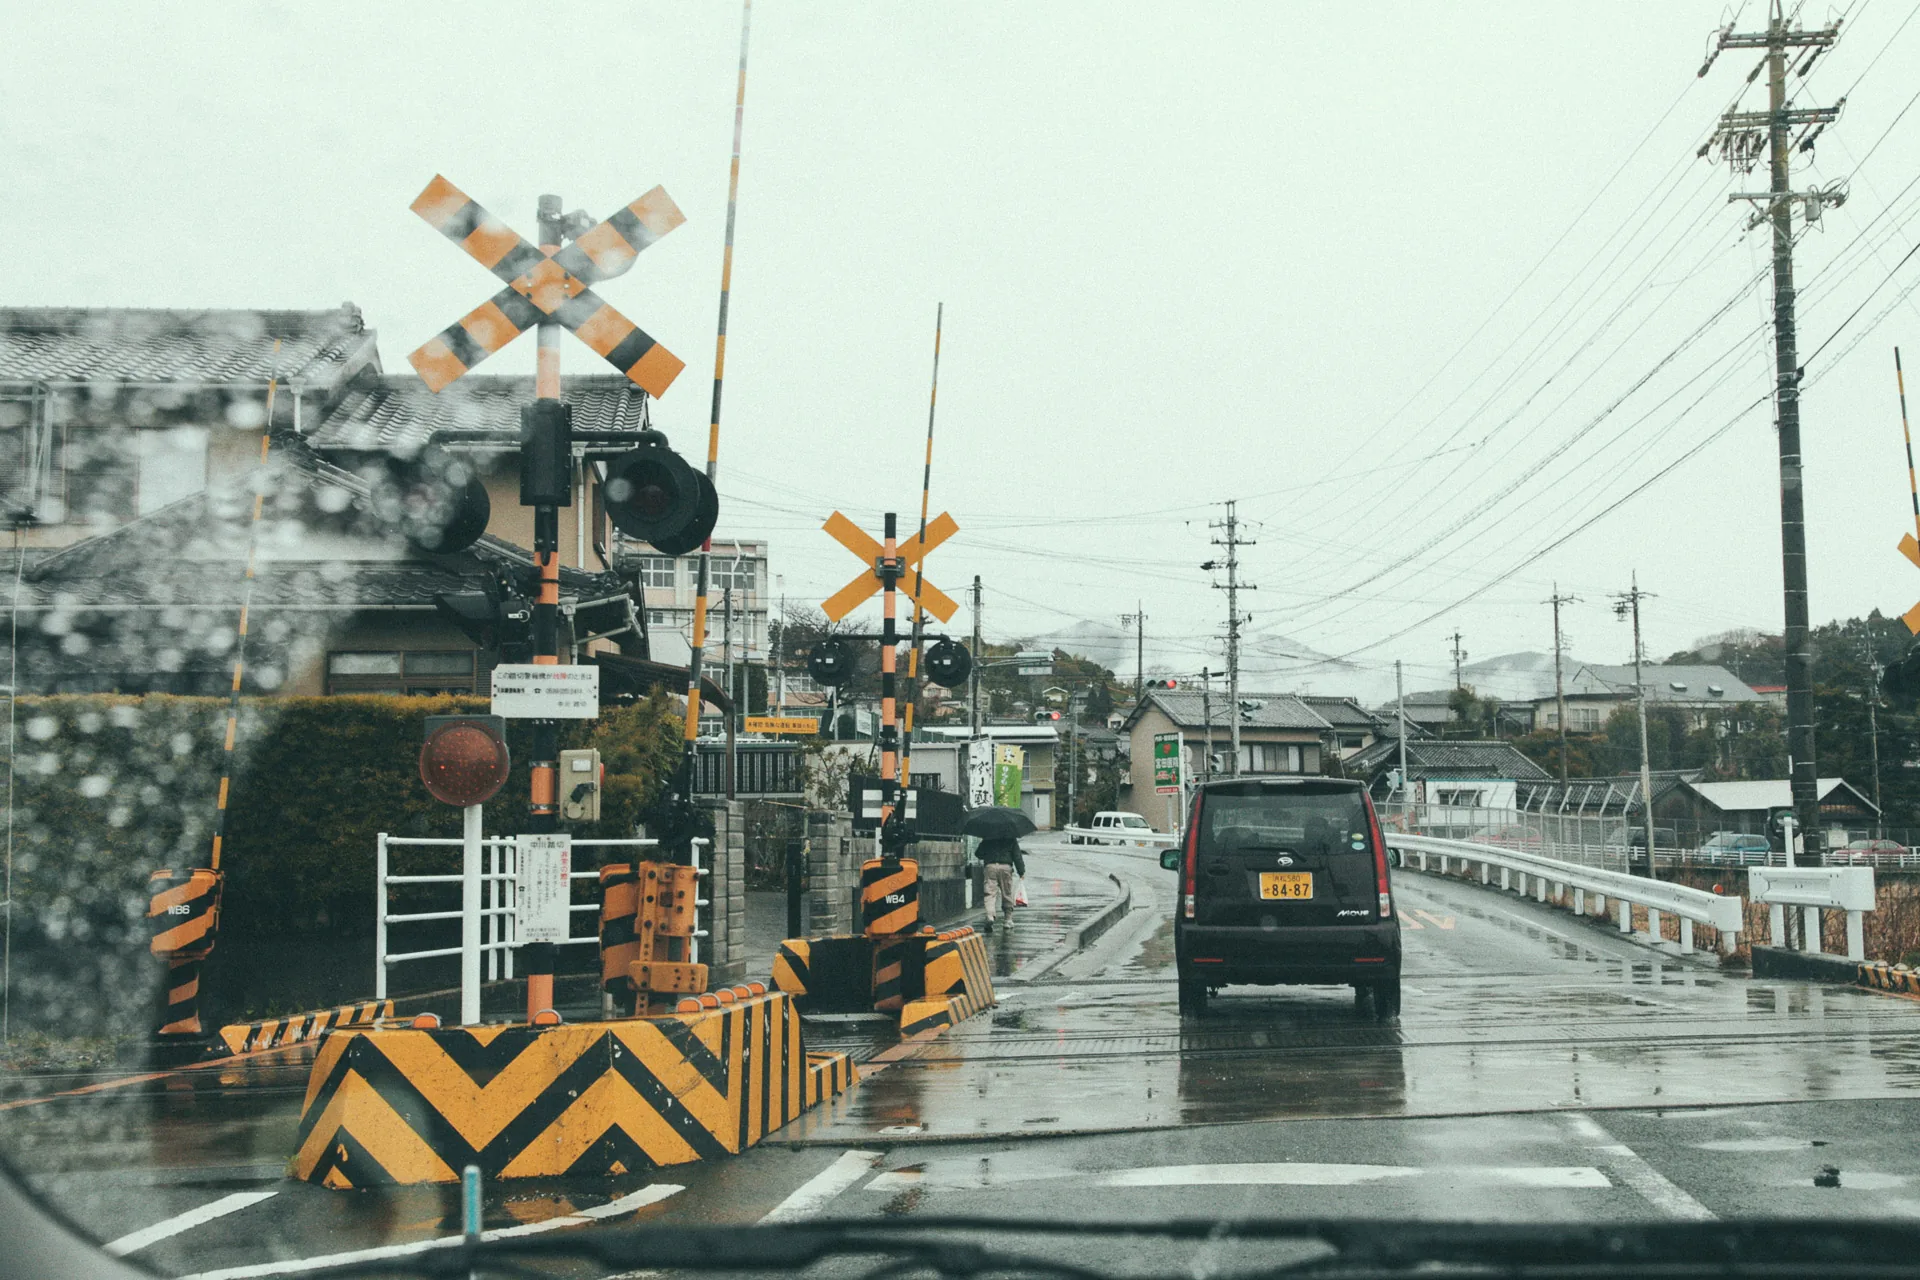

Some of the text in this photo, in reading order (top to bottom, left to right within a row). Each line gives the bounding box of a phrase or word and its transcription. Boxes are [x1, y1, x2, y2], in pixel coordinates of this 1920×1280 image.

[1272, 883, 1309, 896] 84-87
[885, 894, 905, 904] WB4
[168, 904, 190, 915] WB6
